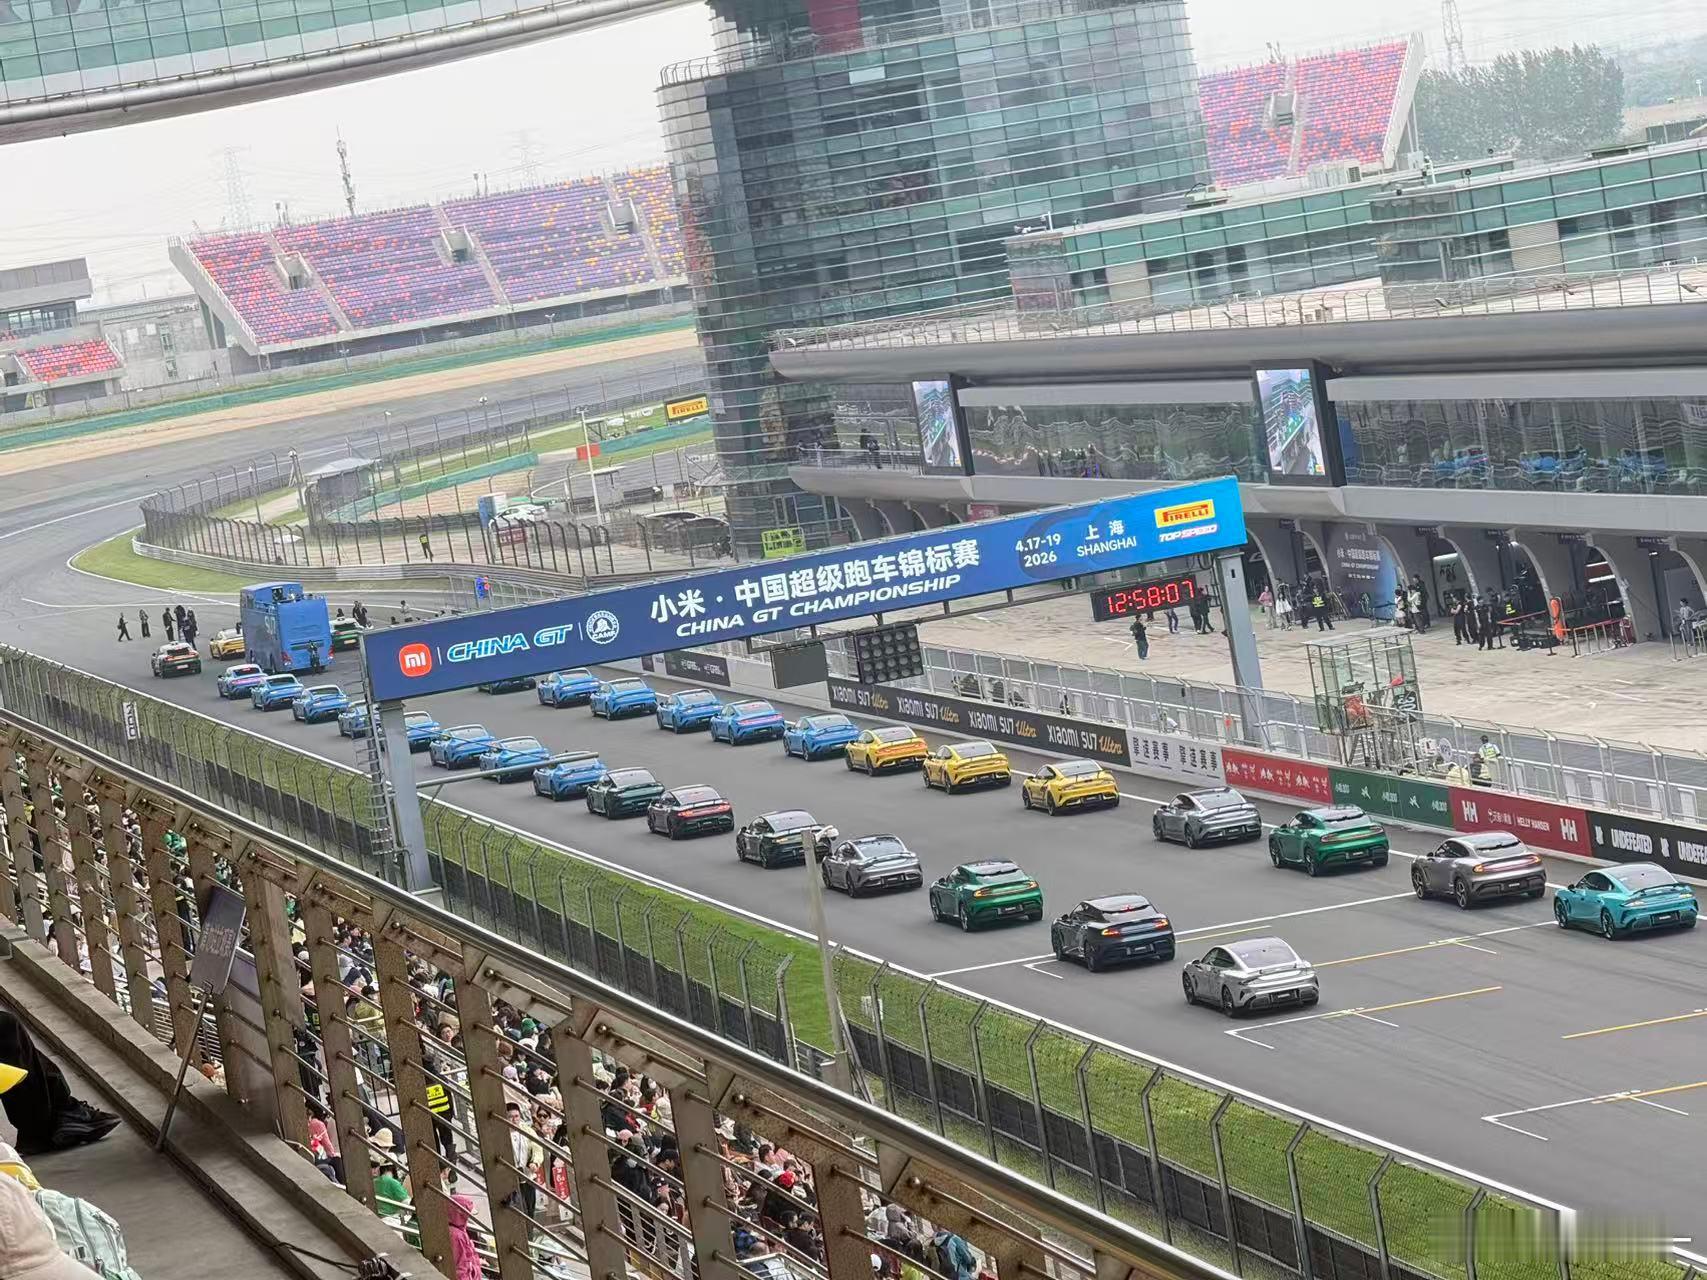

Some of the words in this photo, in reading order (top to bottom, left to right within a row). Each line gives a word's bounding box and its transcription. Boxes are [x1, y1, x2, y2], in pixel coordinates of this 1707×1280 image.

[671, 400, 704, 416] PIRELLI
[1162, 504, 1209, 522] PIRELLI
[1085, 520, 1125, 541] 上海
[1015, 533, 1062, 553] 4.17-19
[1076, 535, 1137, 557] SHANGHAI
[1023, 550, 1058, 568] 2026
[676, 614, 745, 637] CHINA
[752, 606, 783, 623] GT
[789, 574, 961, 617] CHAMPIONSHIP
[1107, 580, 1195, 613] 12:58:07
[447, 632, 531, 663] CHINA
[533, 624, 574, 647] GT
[857, 690, 871, 706] SU7
[871, 689, 889, 709] Ultra
[925, 701, 939, 720] SU7
[939, 705, 960, 723] Ultra
[1000, 716, 1014, 735] SU7
[1015, 720, 1038, 738] Ultra
[1081, 731, 1098, 750] SU7
[1099, 735, 1124, 755] Ultra
[1461, 800, 1479, 823] HH
[1560, 817, 1578, 842] HH
[1611, 828, 1653, 854] UNDEFEATED
